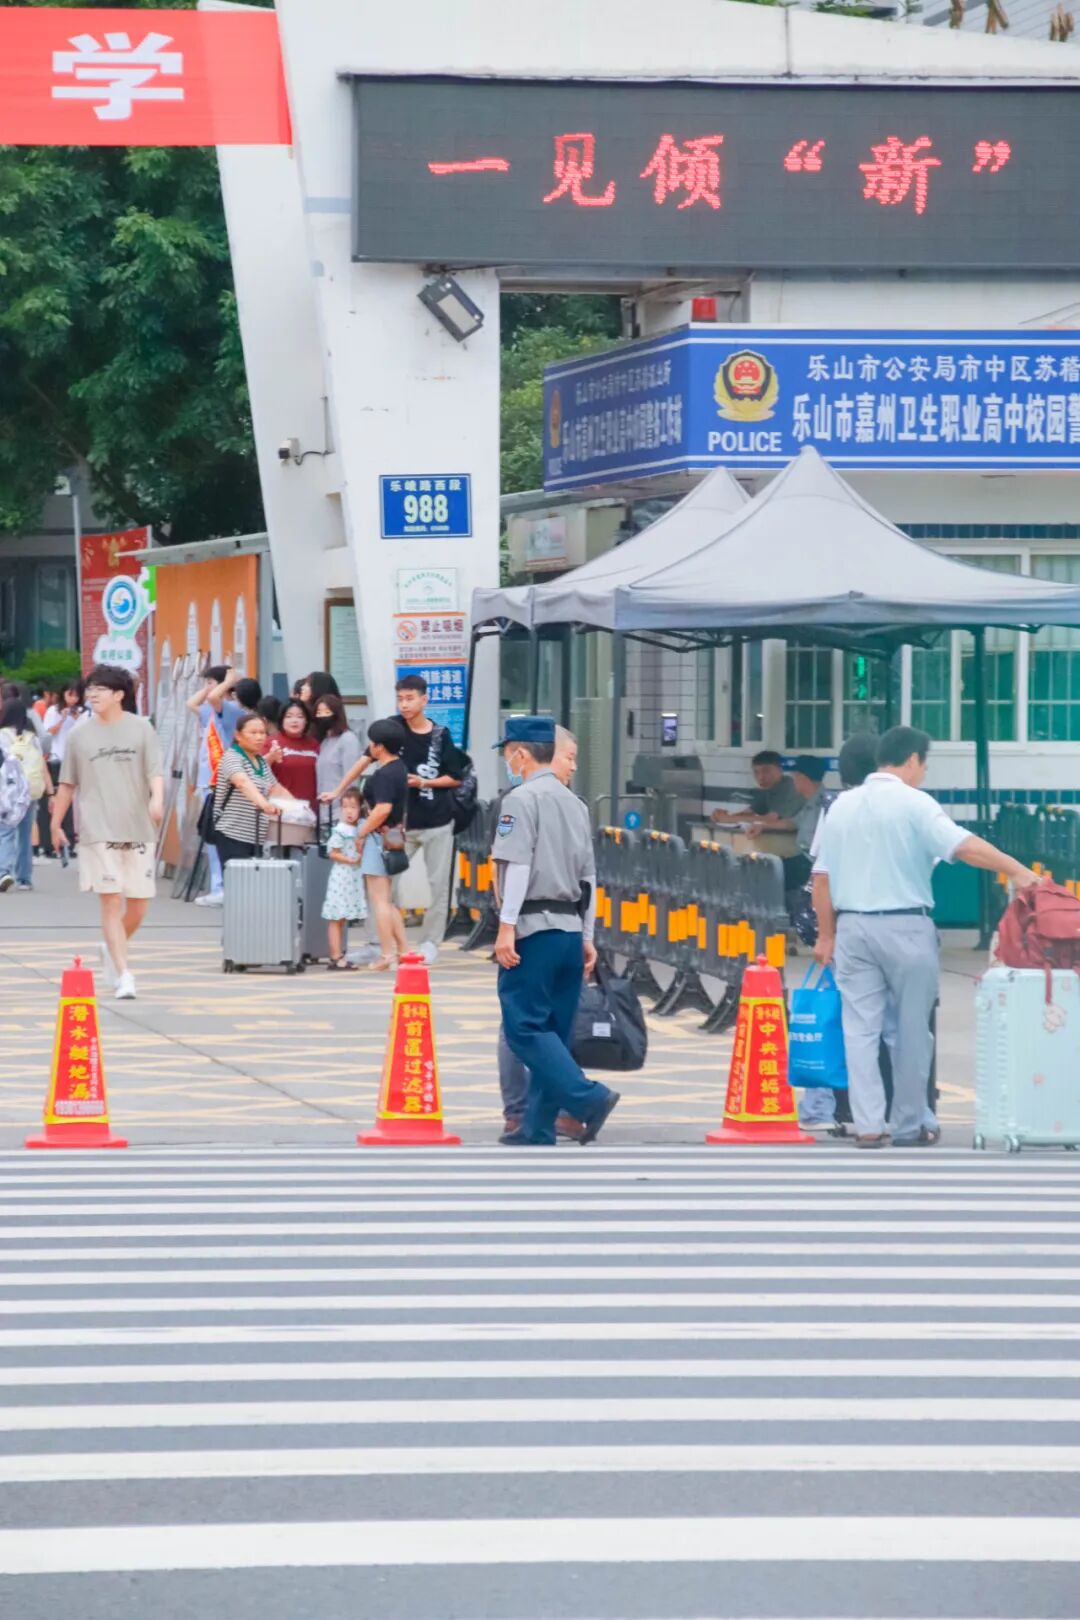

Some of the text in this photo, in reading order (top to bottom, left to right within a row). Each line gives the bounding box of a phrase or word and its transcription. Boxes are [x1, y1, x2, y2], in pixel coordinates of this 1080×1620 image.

[50, 31, 186, 121] 学
[807, 353, 1080, 383] 乐山市公安局市中区苏稽
[707, 431, 783, 453] POLICE
[403, 494, 449, 523] 988
